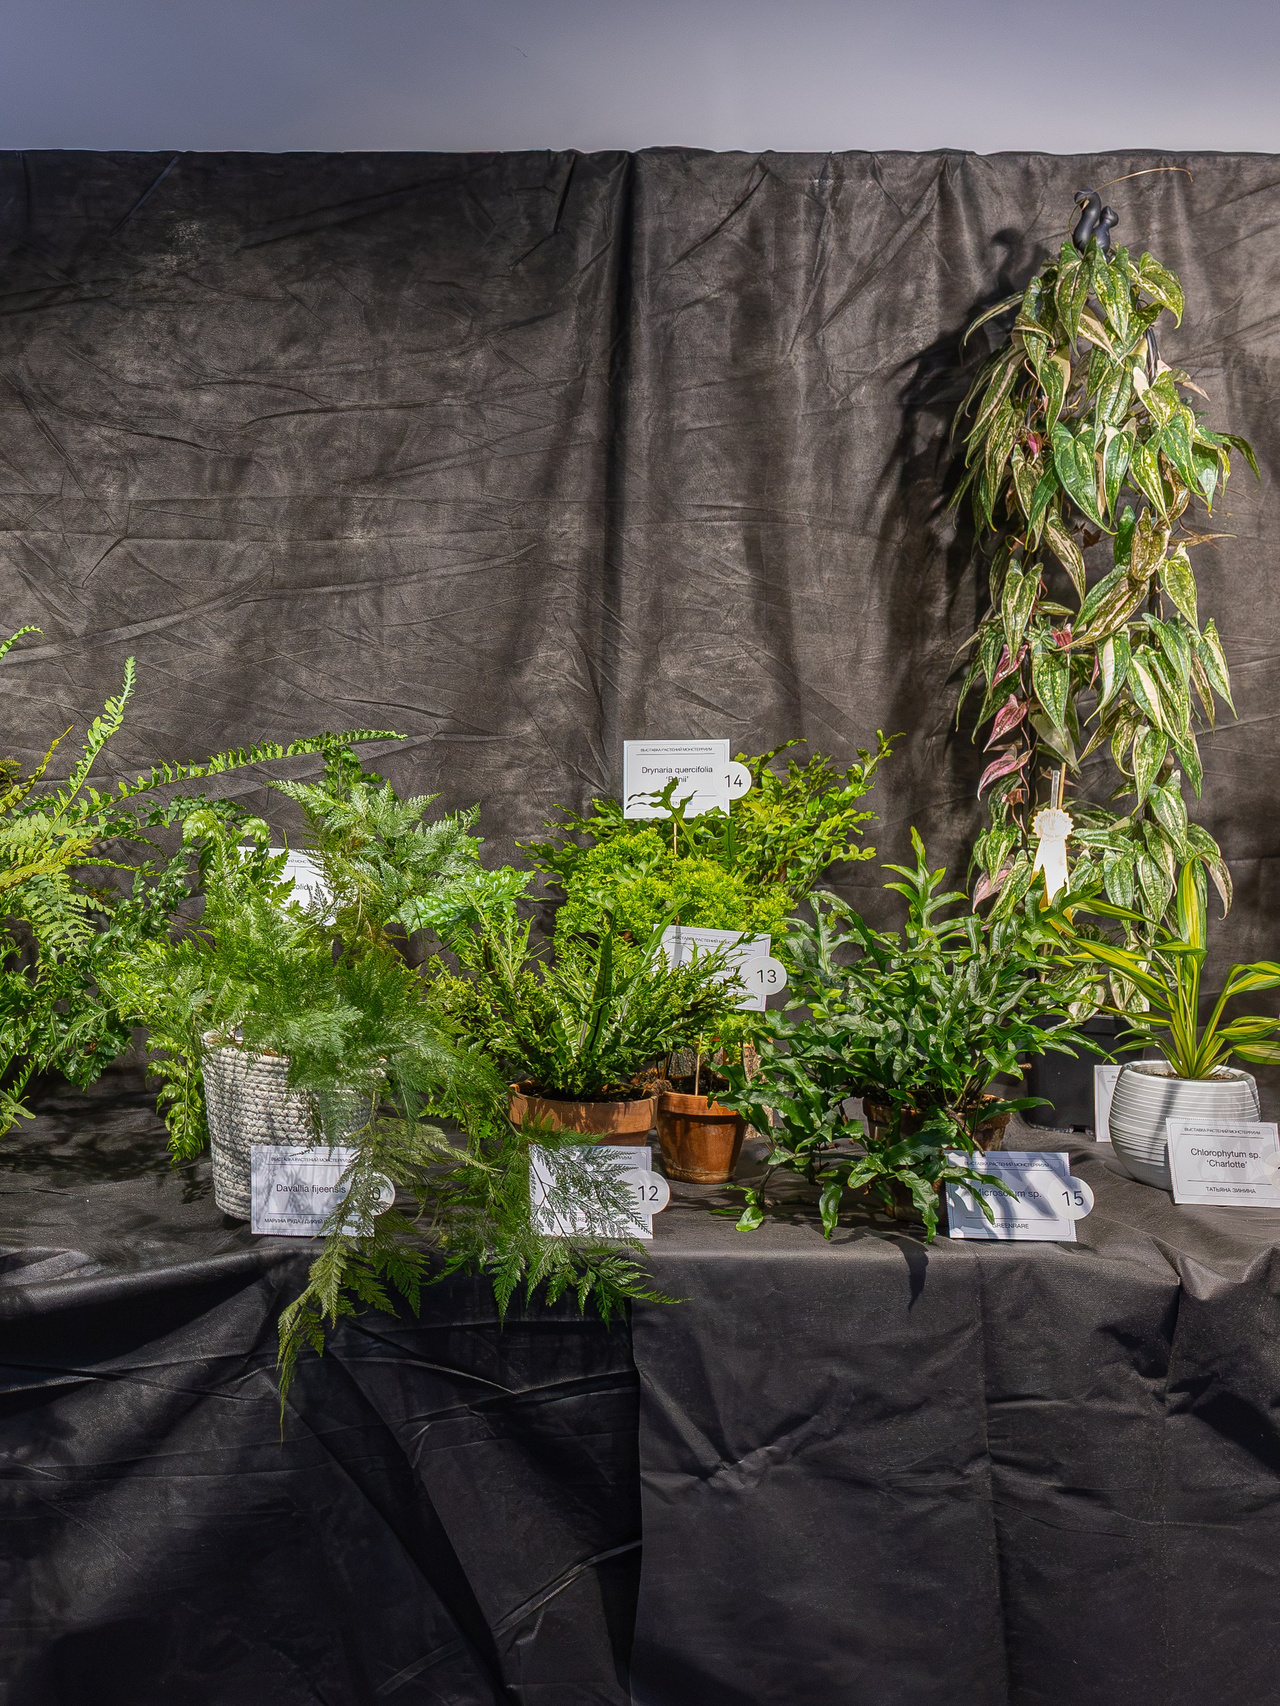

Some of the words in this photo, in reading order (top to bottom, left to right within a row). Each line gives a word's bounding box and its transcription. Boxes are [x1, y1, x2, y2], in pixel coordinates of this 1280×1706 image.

[641, 766, 673, 775] Drynaria
[674, 765, 713, 774] quercifolia
[724, 774, 743, 788] 14
[756, 969, 777, 984] 13
[1190, 1147, 1247, 1159] Chlorophytum
[1248, 1151, 1261, 1160] sp.
[1206, 1159, 1248, 1169] 'Charlotte'
[276, 1183, 310, 1193] Davallia
[311, 1184, 347, 1195] fijeensis
[637, 1185, 659, 1202] 12
[1027, 1190, 1042, 1199] sp.
[1061, 1190, 1085, 1207] 15
